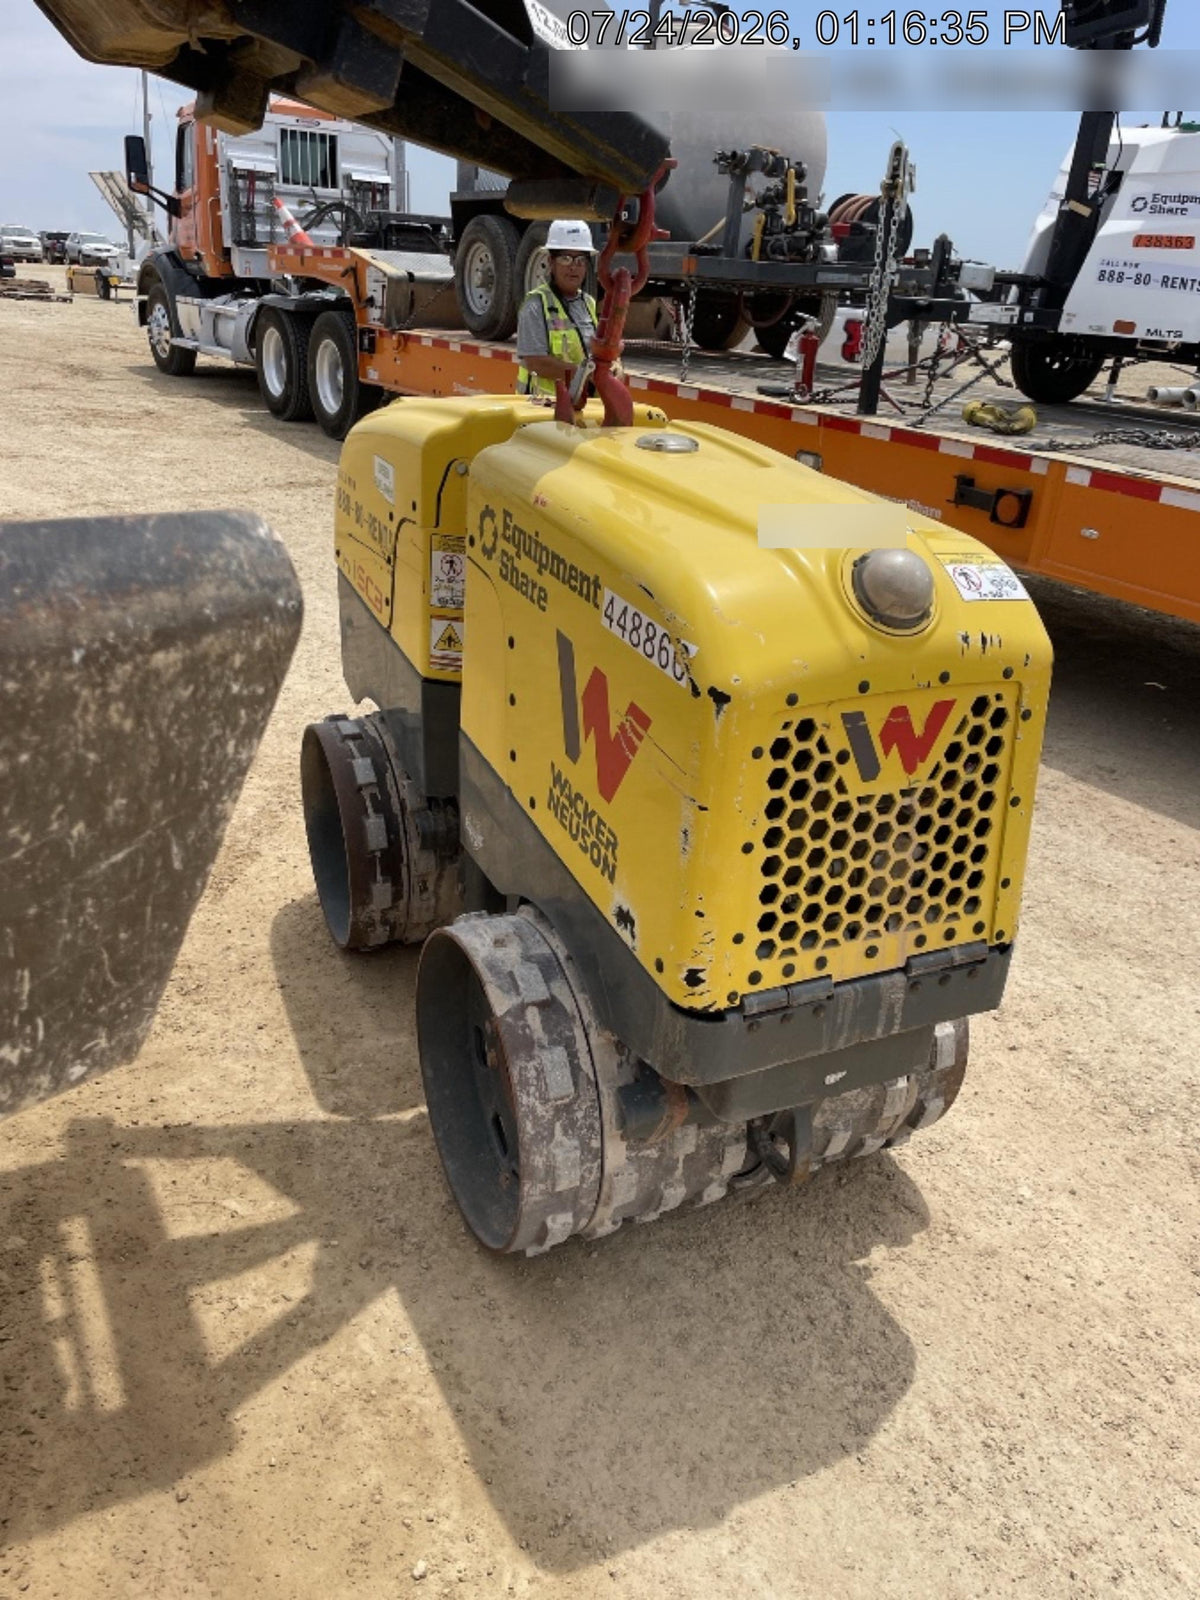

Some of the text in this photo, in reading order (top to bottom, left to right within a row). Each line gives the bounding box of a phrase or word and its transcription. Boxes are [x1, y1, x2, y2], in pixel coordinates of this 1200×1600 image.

[1147, 204, 1188, 216] Share
[498, 548, 548, 613] Share
[501, 507, 602, 611] Equipment
[547, 787, 618, 885] NEUSON
[550, 759, 619, 864] WACKER
